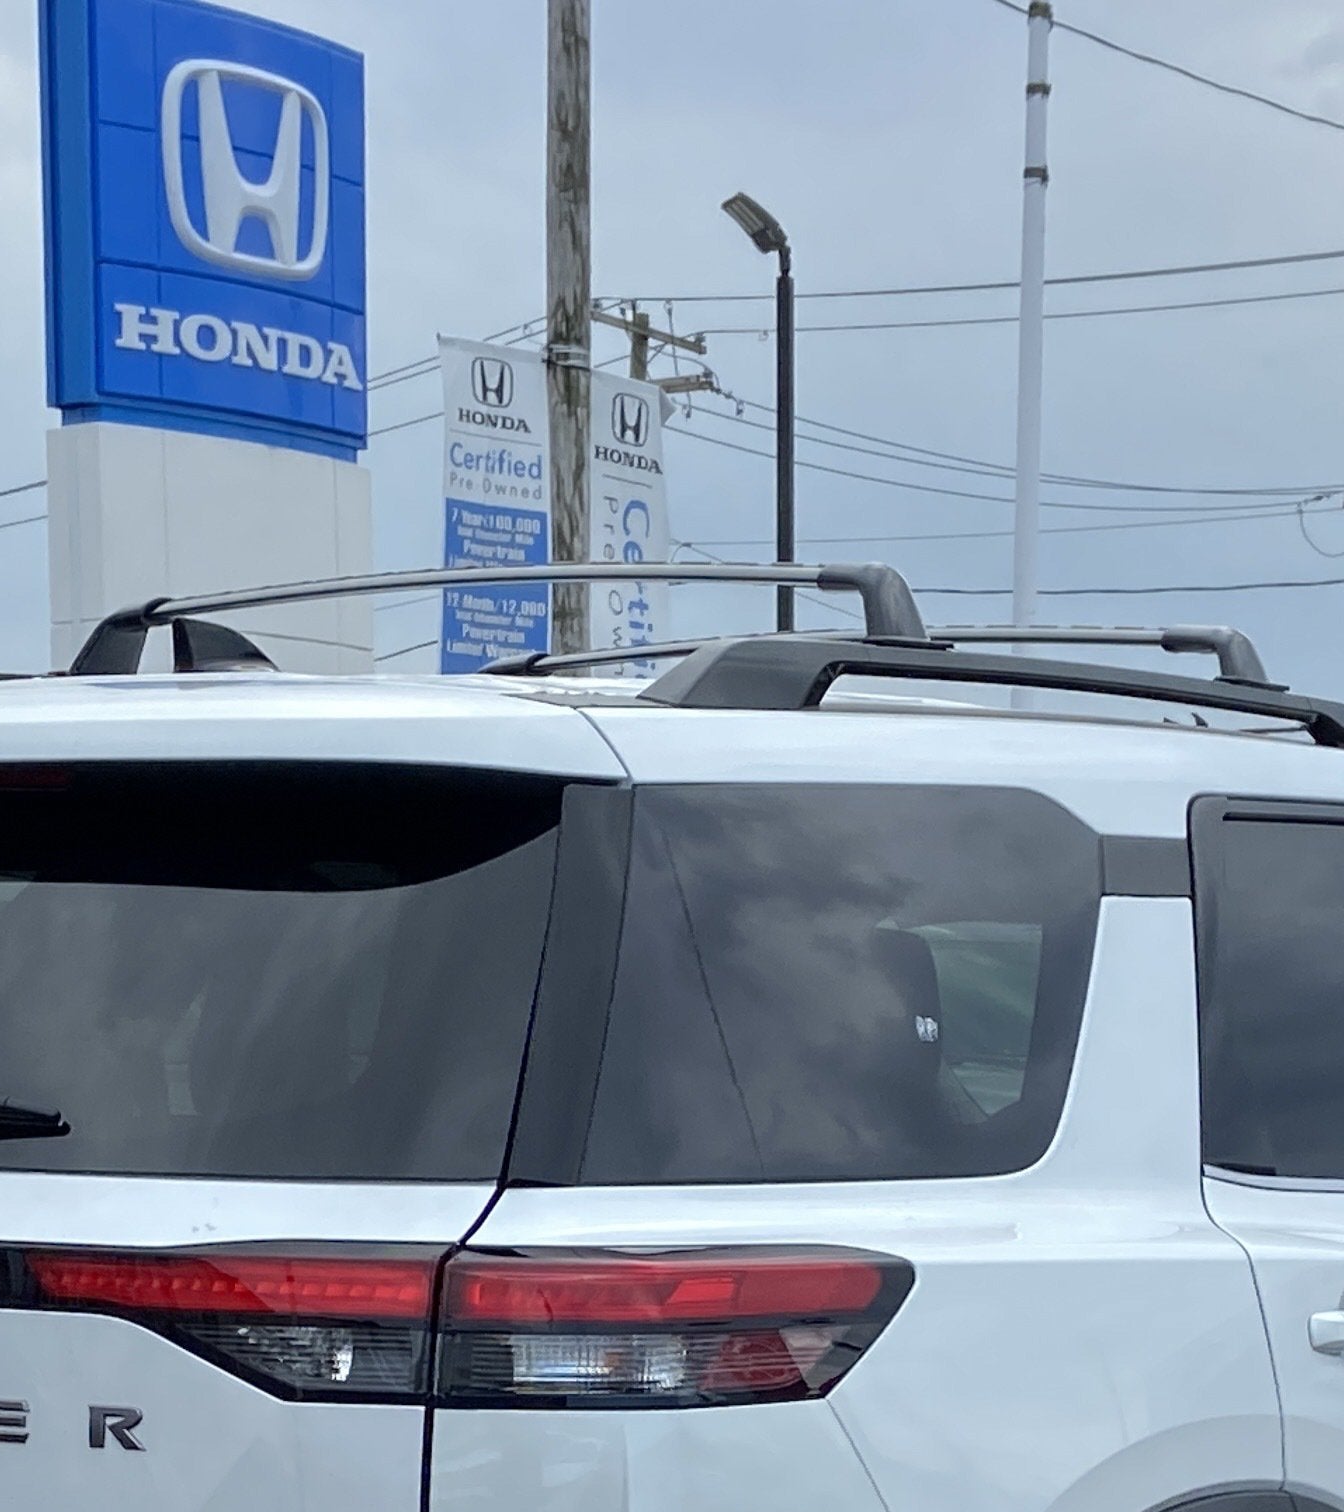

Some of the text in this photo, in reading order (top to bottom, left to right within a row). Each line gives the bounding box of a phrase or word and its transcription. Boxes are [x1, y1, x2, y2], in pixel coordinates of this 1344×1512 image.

[113, 302, 363, 391] HONDA
[457, 407, 532, 434] HONDA
[449, 442, 543, 481] Certified
[593, 445, 664, 475] HONDA
[449, 472, 543, 500] Pre Owned
